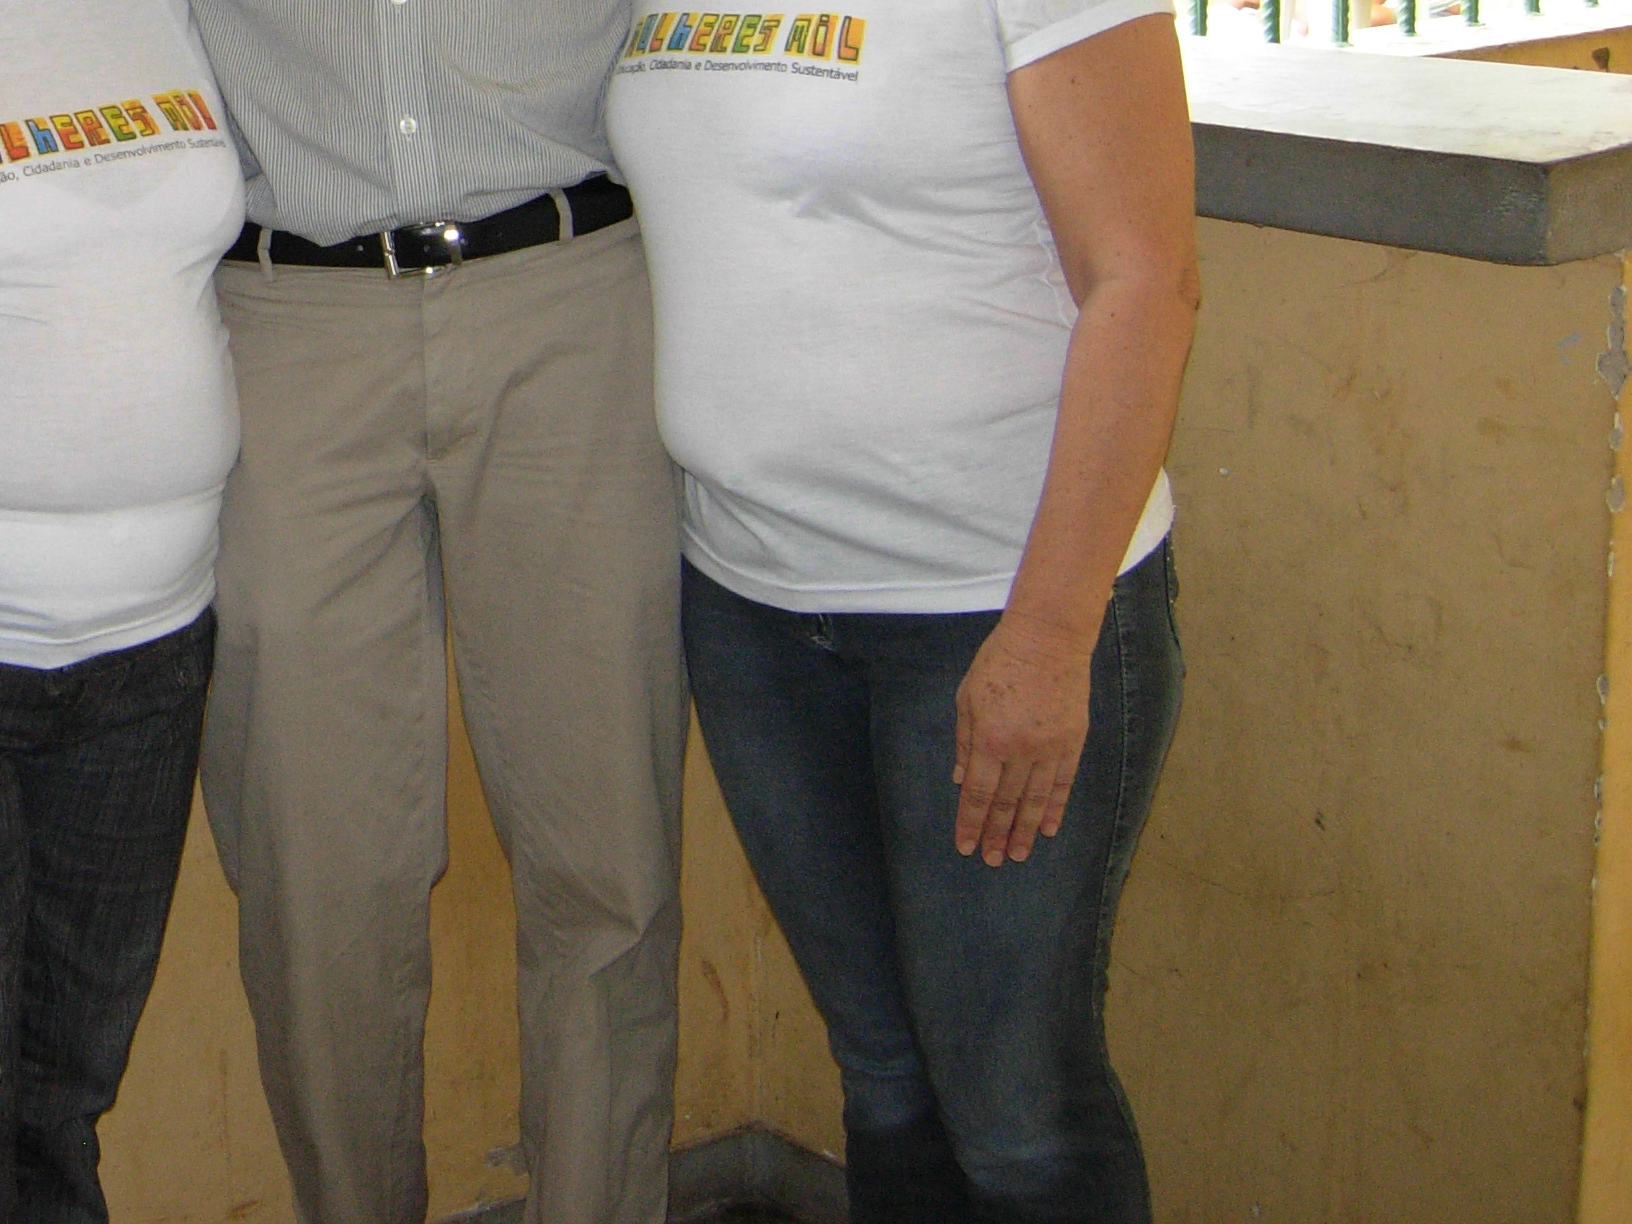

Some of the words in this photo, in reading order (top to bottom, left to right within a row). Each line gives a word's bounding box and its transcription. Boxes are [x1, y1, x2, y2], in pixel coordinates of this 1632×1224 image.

[695, 62, 702, 71] e
[704, 59, 788, 74] Desenvolvimento
[791, 62, 859, 82] Sustentável
[22, 156, 81, 177] Cidadania
[84, 156, 92, 166] e
[95, 140, 186, 165] Desenvolvimento
